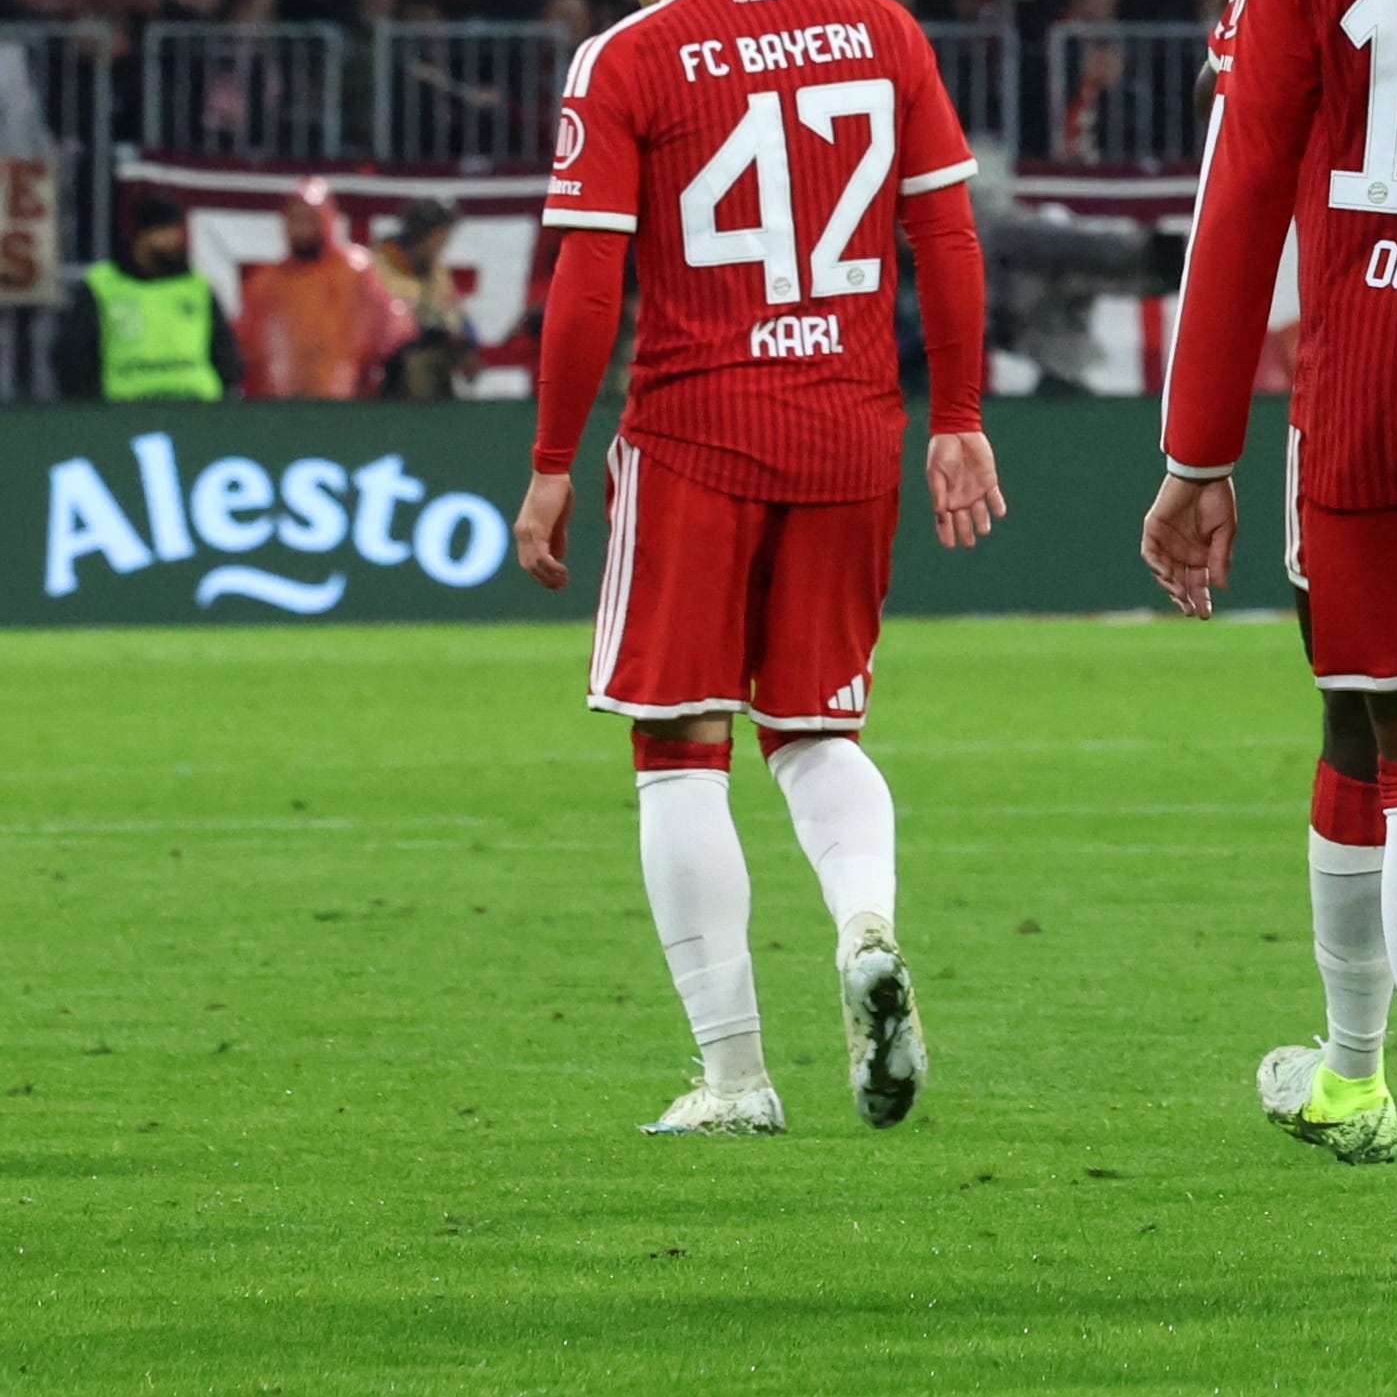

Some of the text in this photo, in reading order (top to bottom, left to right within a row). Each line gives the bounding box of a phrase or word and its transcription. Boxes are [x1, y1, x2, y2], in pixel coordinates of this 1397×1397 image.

[680, 22, 874, 82] FC BAYERN
[679, 77, 896, 305] 42
[751, 314, 844, 358] KARL
[44, 430, 511, 598] Alesto
